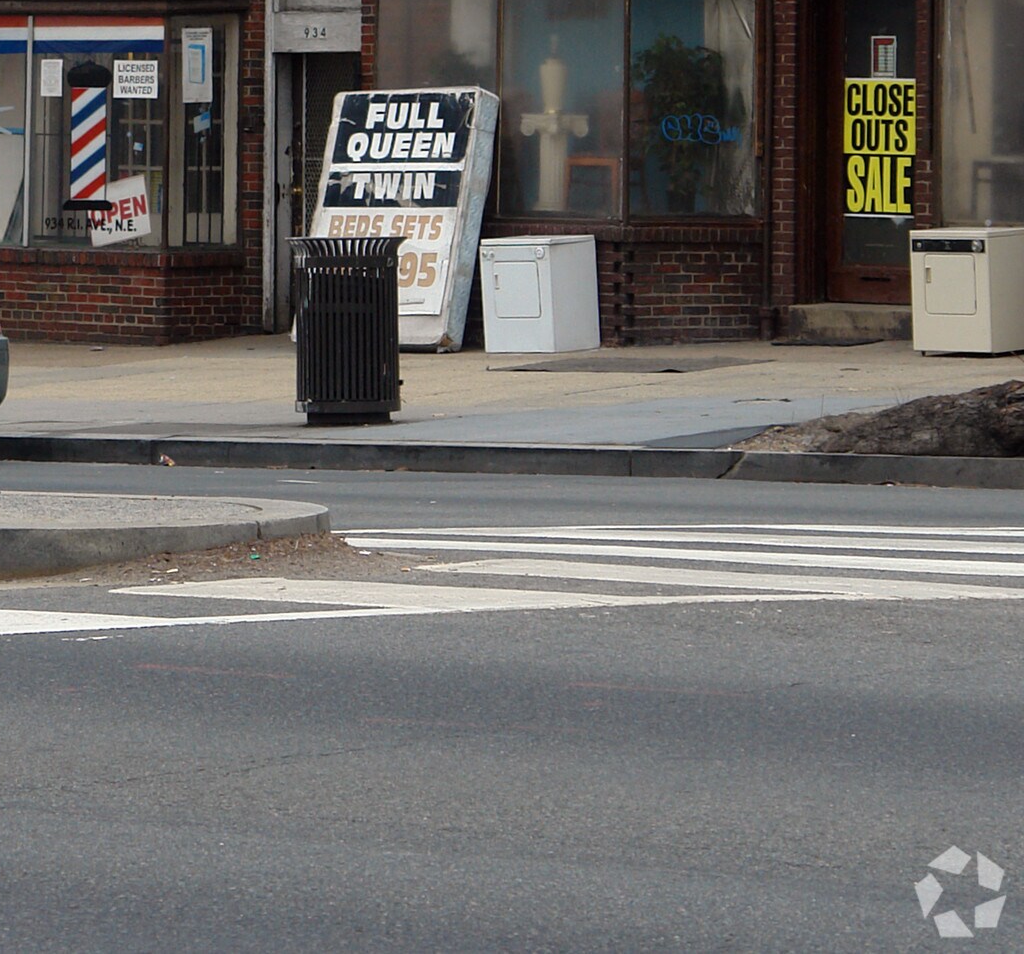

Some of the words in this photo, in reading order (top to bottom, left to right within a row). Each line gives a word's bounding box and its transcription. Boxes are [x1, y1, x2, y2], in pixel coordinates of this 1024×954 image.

[304, 27, 326, 38] 934
[117, 64, 155, 72] LICENSED
[118, 75, 155, 84] BARBERS
[120, 85, 153, 94] WANTED
[846, 83, 914, 117] CLOSE
[365, 102, 445, 130] FULL
[346, 132, 456, 162] QUEEN
[851, 118, 908, 152] OUTS
[352, 172, 437, 200] TWIN
[846, 155, 912, 214] SALE
[91, 194, 147, 226] OPEN
[115, 219, 137, 232] N.E.
[328, 215, 384, 237] BEDS
[389, 214, 443, 240] SETS
